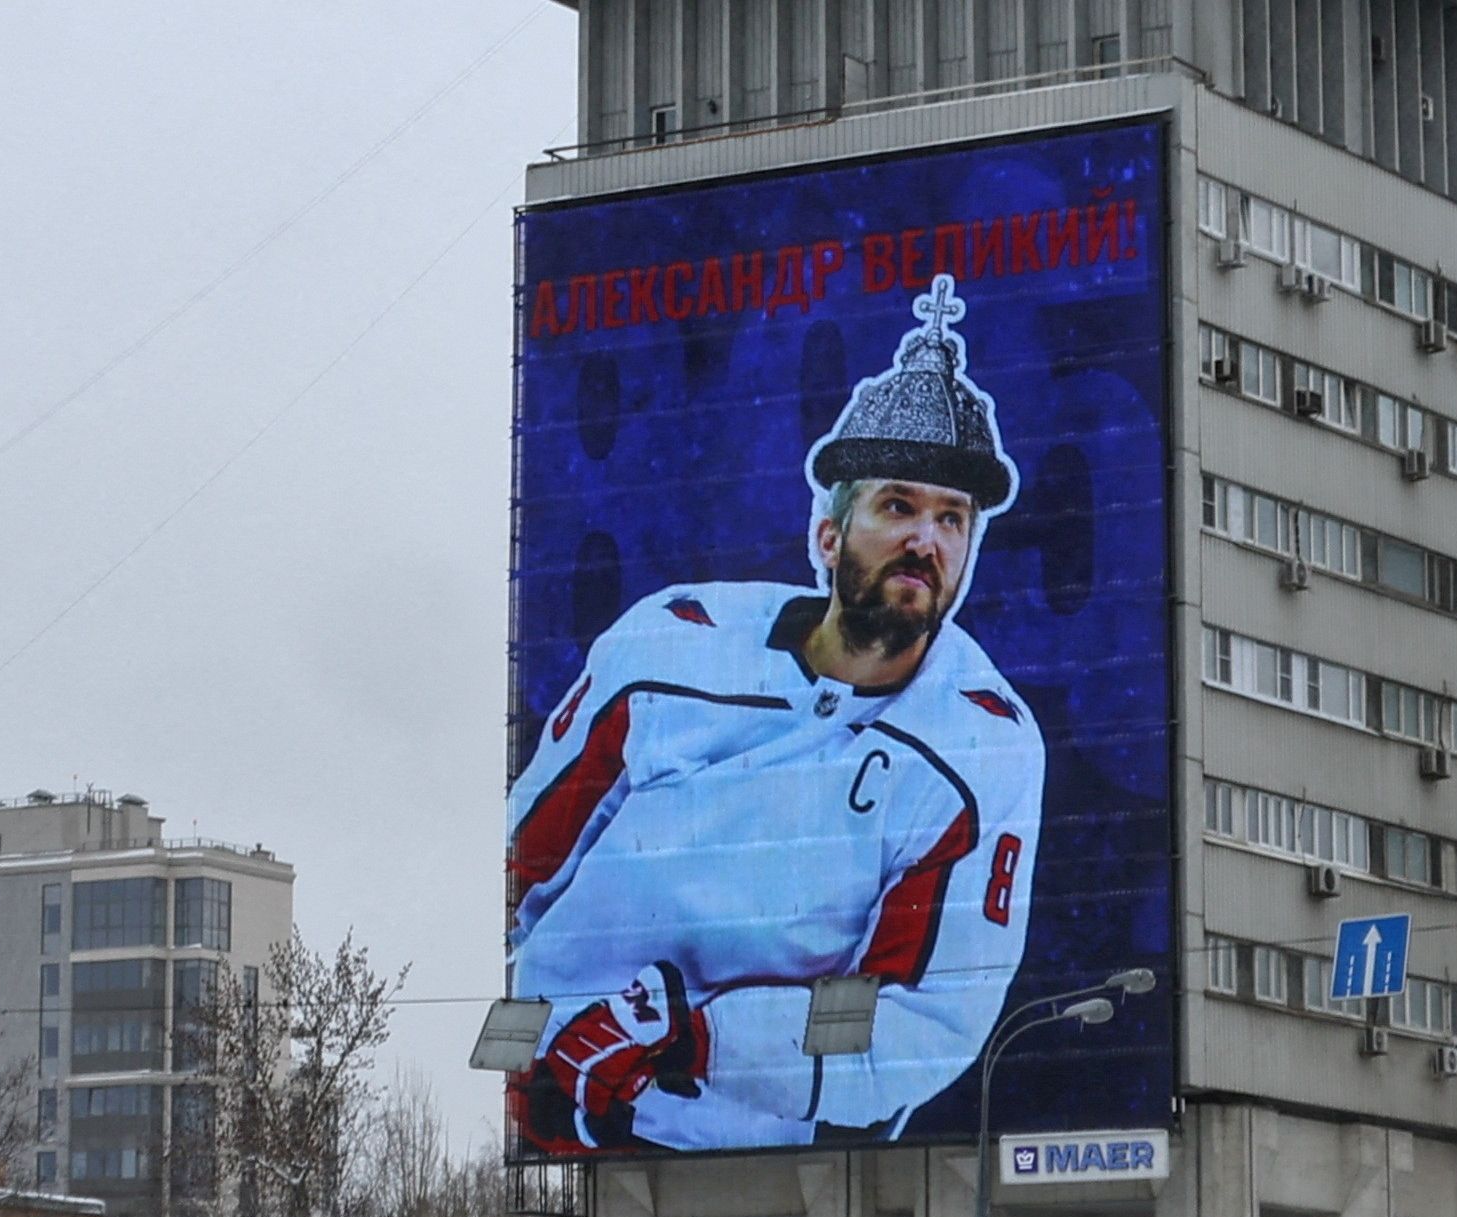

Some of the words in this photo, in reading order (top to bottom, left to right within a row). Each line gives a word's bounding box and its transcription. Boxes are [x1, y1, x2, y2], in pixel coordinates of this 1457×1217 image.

[530, 240, 845, 338] АЛЕКСАНДР
[862, 186, 1138, 293] ВЕЛИКИЙ!
[983, 832, 1023, 927] 8
[1045, 1141, 1155, 1174] MAER
